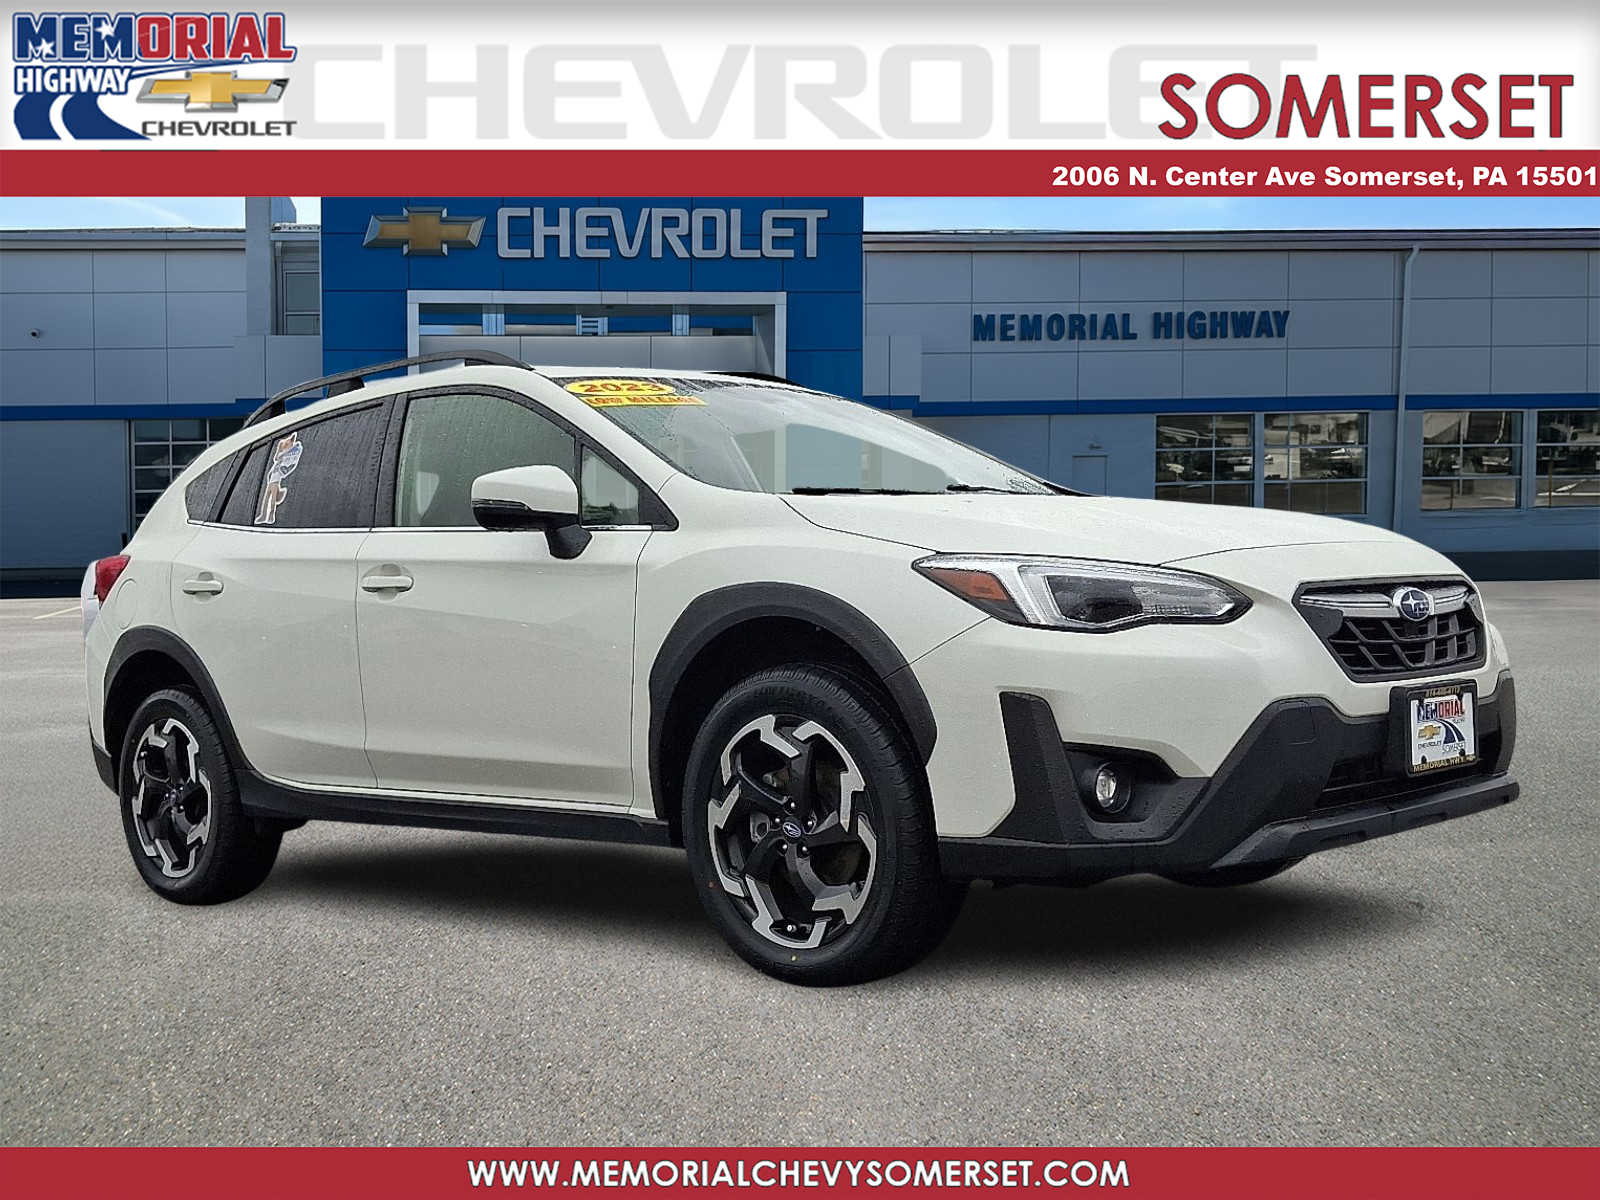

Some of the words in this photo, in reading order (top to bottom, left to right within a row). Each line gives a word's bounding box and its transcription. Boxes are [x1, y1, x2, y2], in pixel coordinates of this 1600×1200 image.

[497, 207, 828, 258] CHEVROLET
[972, 312, 1138, 342] MEMORIAL
[1151, 310, 1290, 340] HIGHWAY
